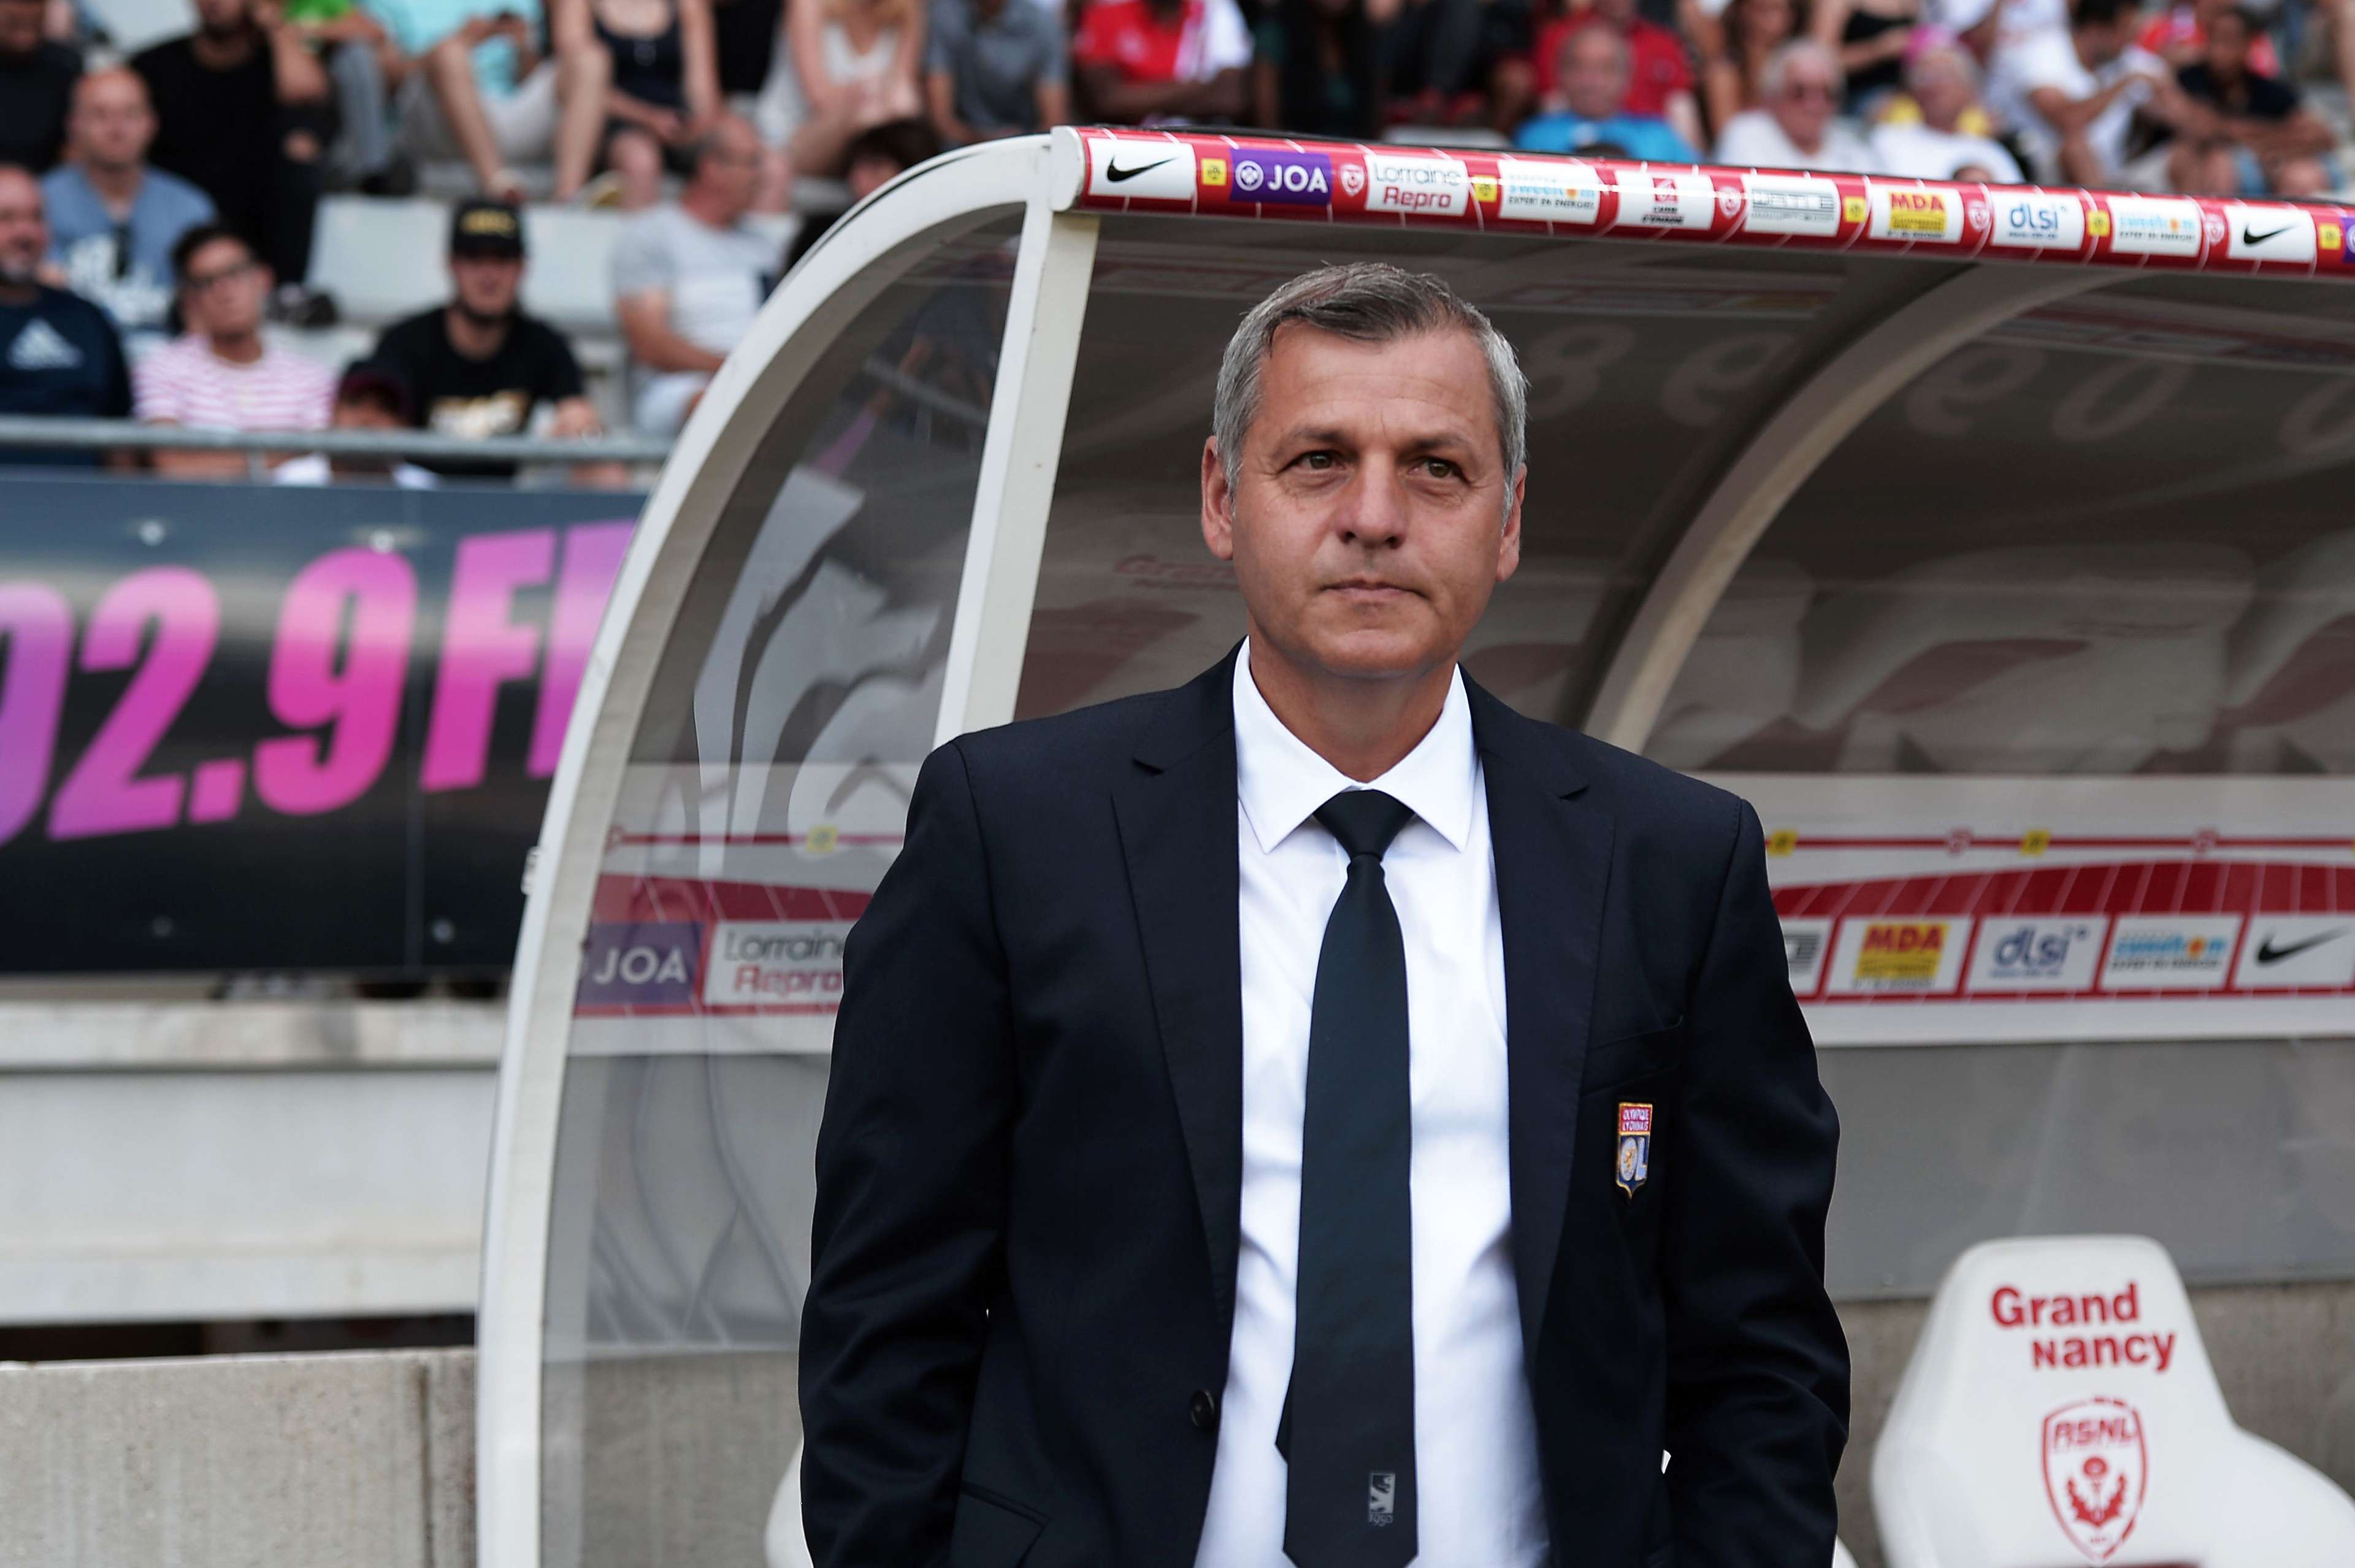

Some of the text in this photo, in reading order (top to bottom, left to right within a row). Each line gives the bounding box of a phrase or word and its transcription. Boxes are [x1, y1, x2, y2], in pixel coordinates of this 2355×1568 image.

[1268, 164, 1328, 193] JOA
[1374, 162, 1461, 186] Lorraine
[1384, 186, 1451, 209] Repro
[1891, 193, 1944, 210] MDA
[2010, 202, 2058, 229] dlsi
[1863, 926, 1943, 951] MDA
[1993, 926, 2070, 966] dlsi
[594, 946, 688, 985] JOA
[1991, 1280, 2140, 1329] Grand
[2031, 1332, 2175, 1374] Nancy
